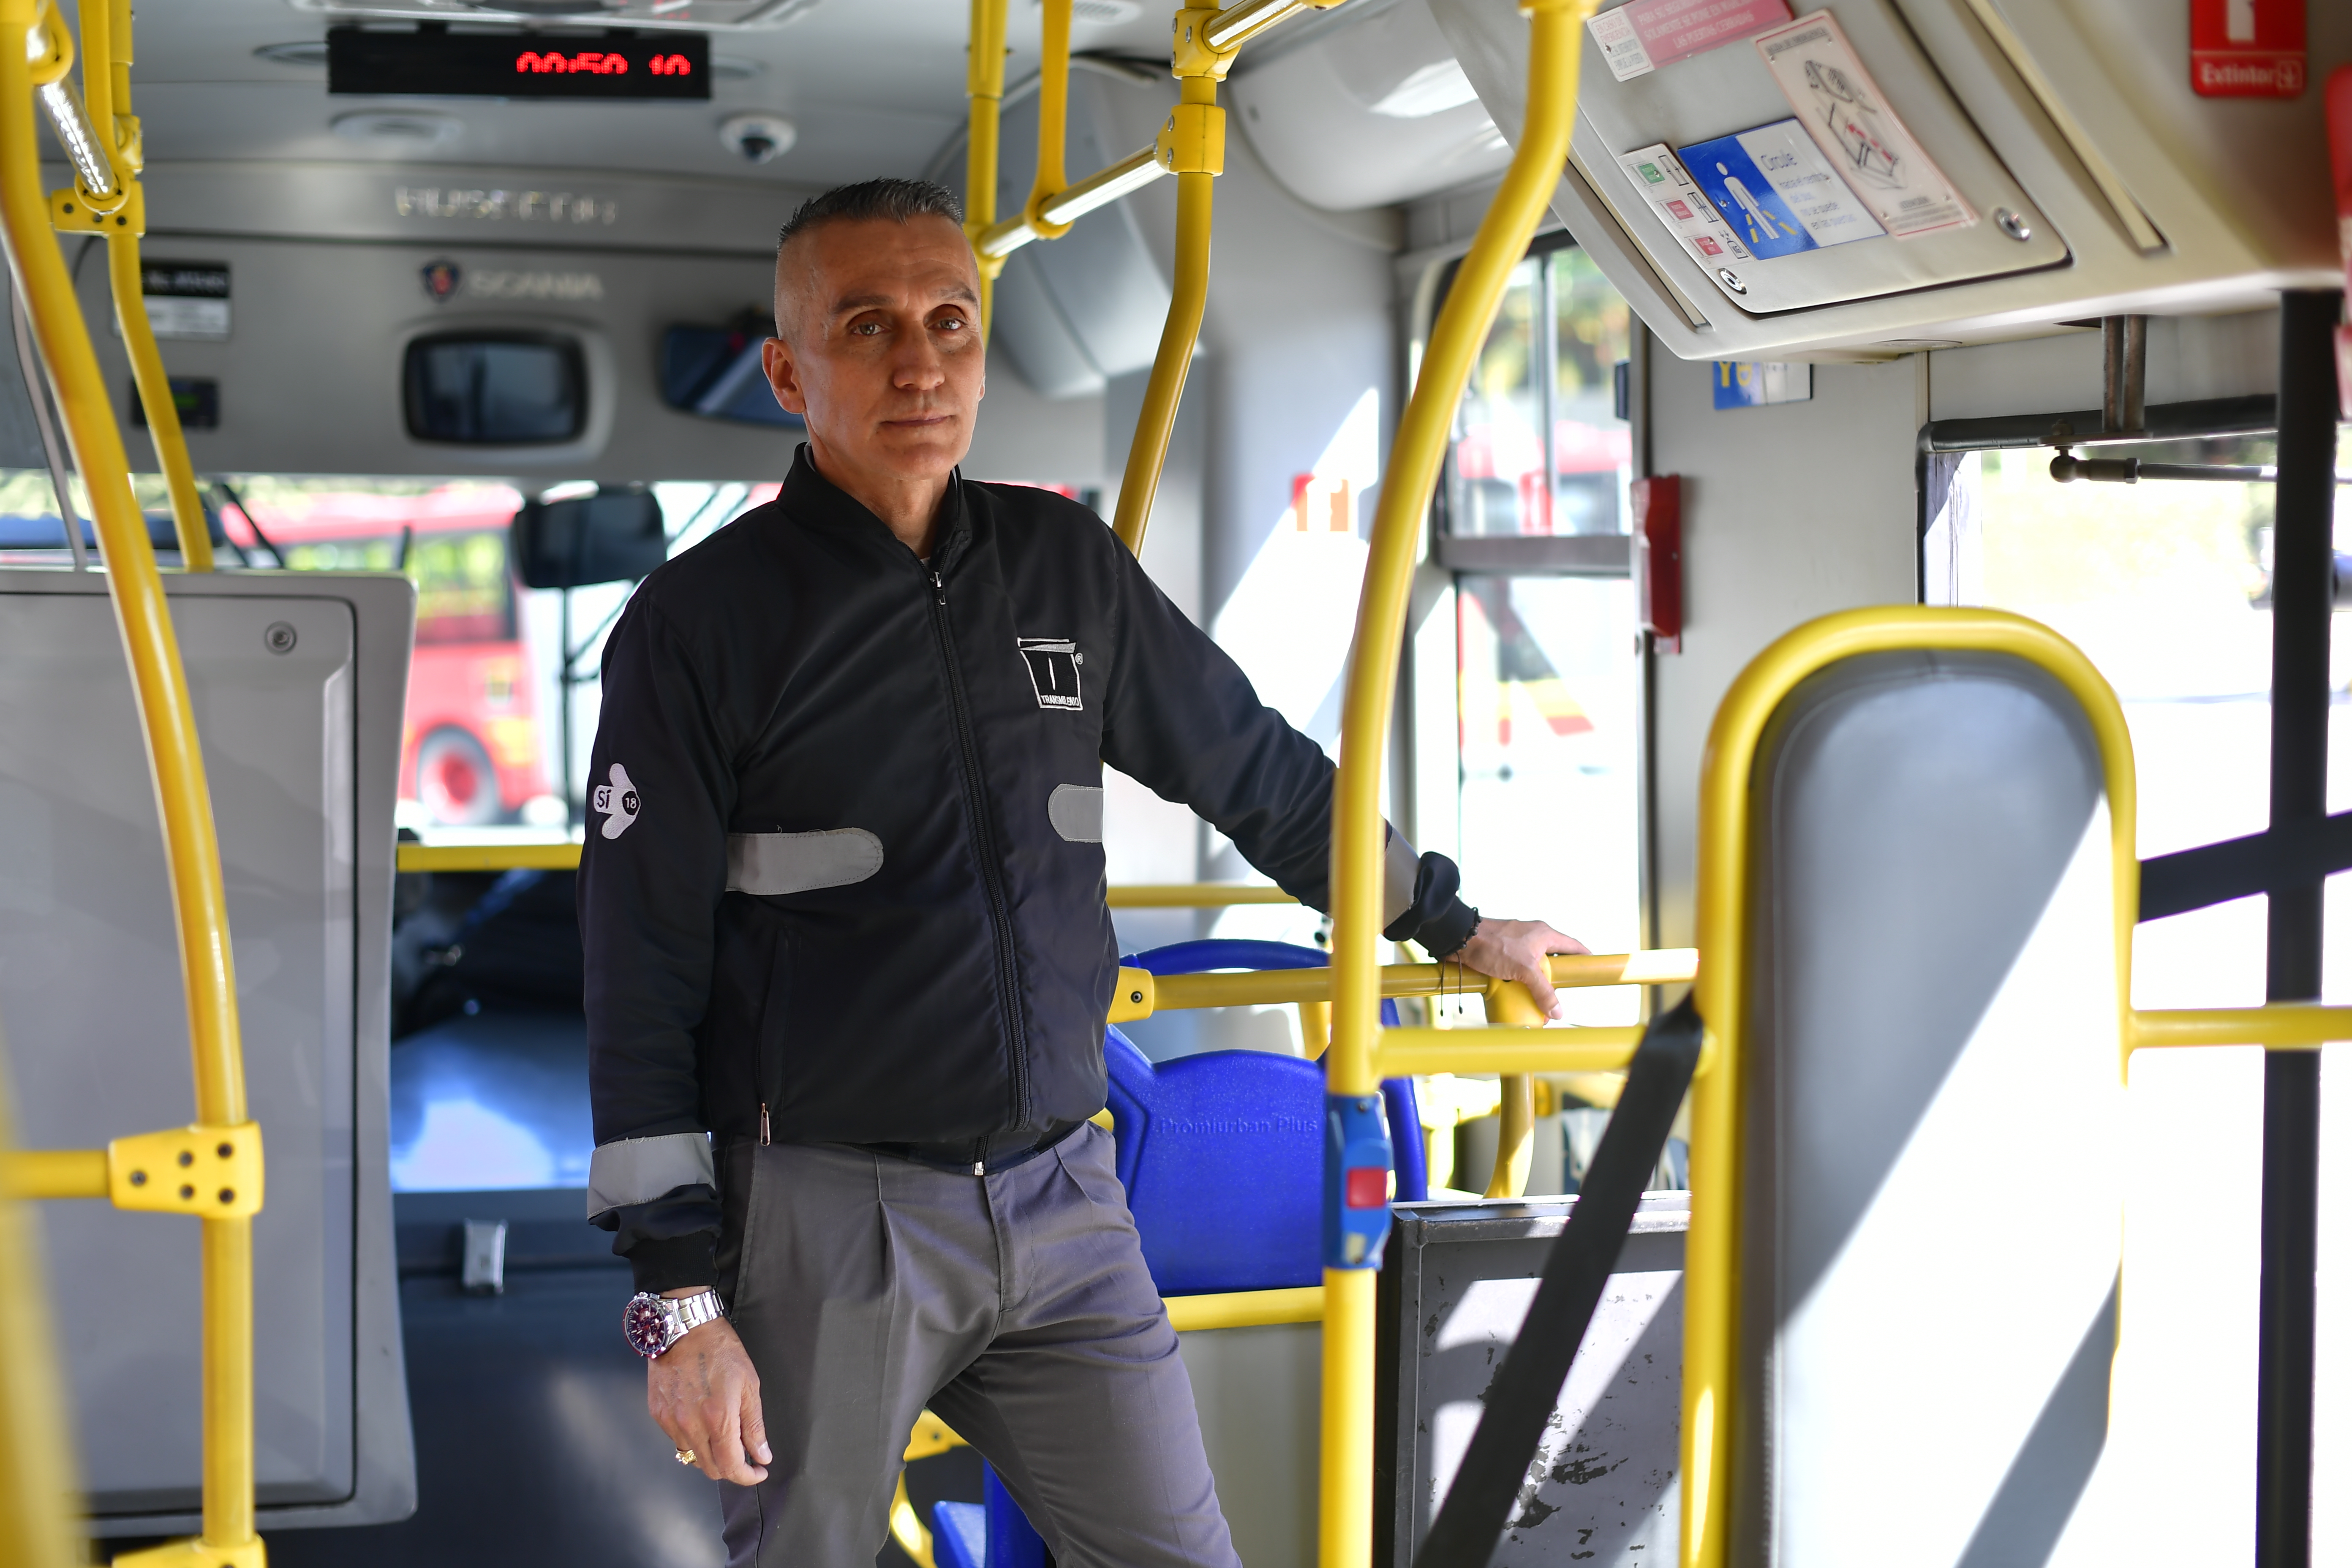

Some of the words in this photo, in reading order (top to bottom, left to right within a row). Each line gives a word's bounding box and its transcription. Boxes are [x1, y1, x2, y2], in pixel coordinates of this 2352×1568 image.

[2201, 63, 2273, 85] Extintor
[1040, 694, 1080, 706] TRANSMILENIO
[625, 797, 637, 809] 18
[1277, 1116, 1318, 1133] Plus
